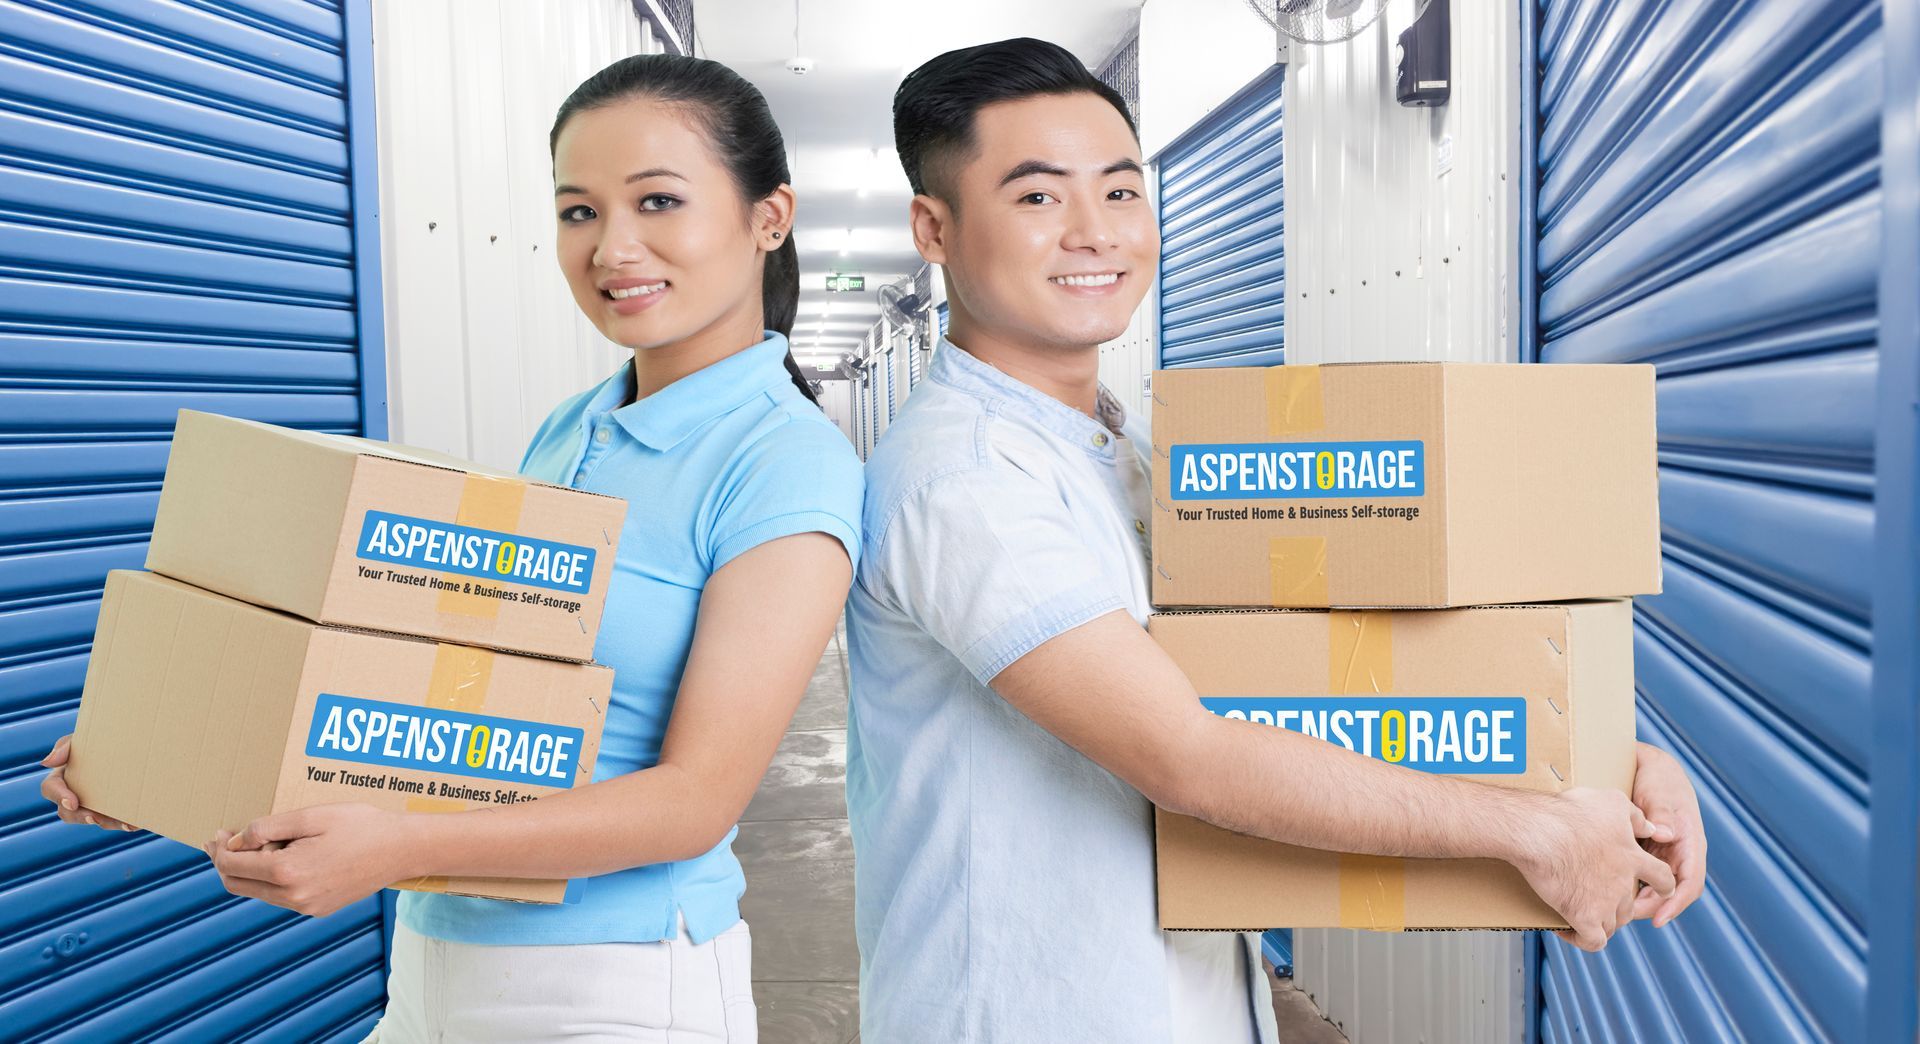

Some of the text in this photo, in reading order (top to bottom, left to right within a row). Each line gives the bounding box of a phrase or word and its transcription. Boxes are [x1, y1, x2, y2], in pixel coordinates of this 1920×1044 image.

[1179, 450, 1416, 492] ASPENSTORAGE
[1176, 505, 1420, 521] Your Trusted Home & Business Self-storage
[366, 519, 588, 587] ASPENSTORAGE
[358, 565, 582, 614] Your Trusted Home & Business Self-storage
[316, 705, 575, 779] ASPENSTORAGE
[306, 765, 538, 805] Your Trusted Home & Business Self-st
